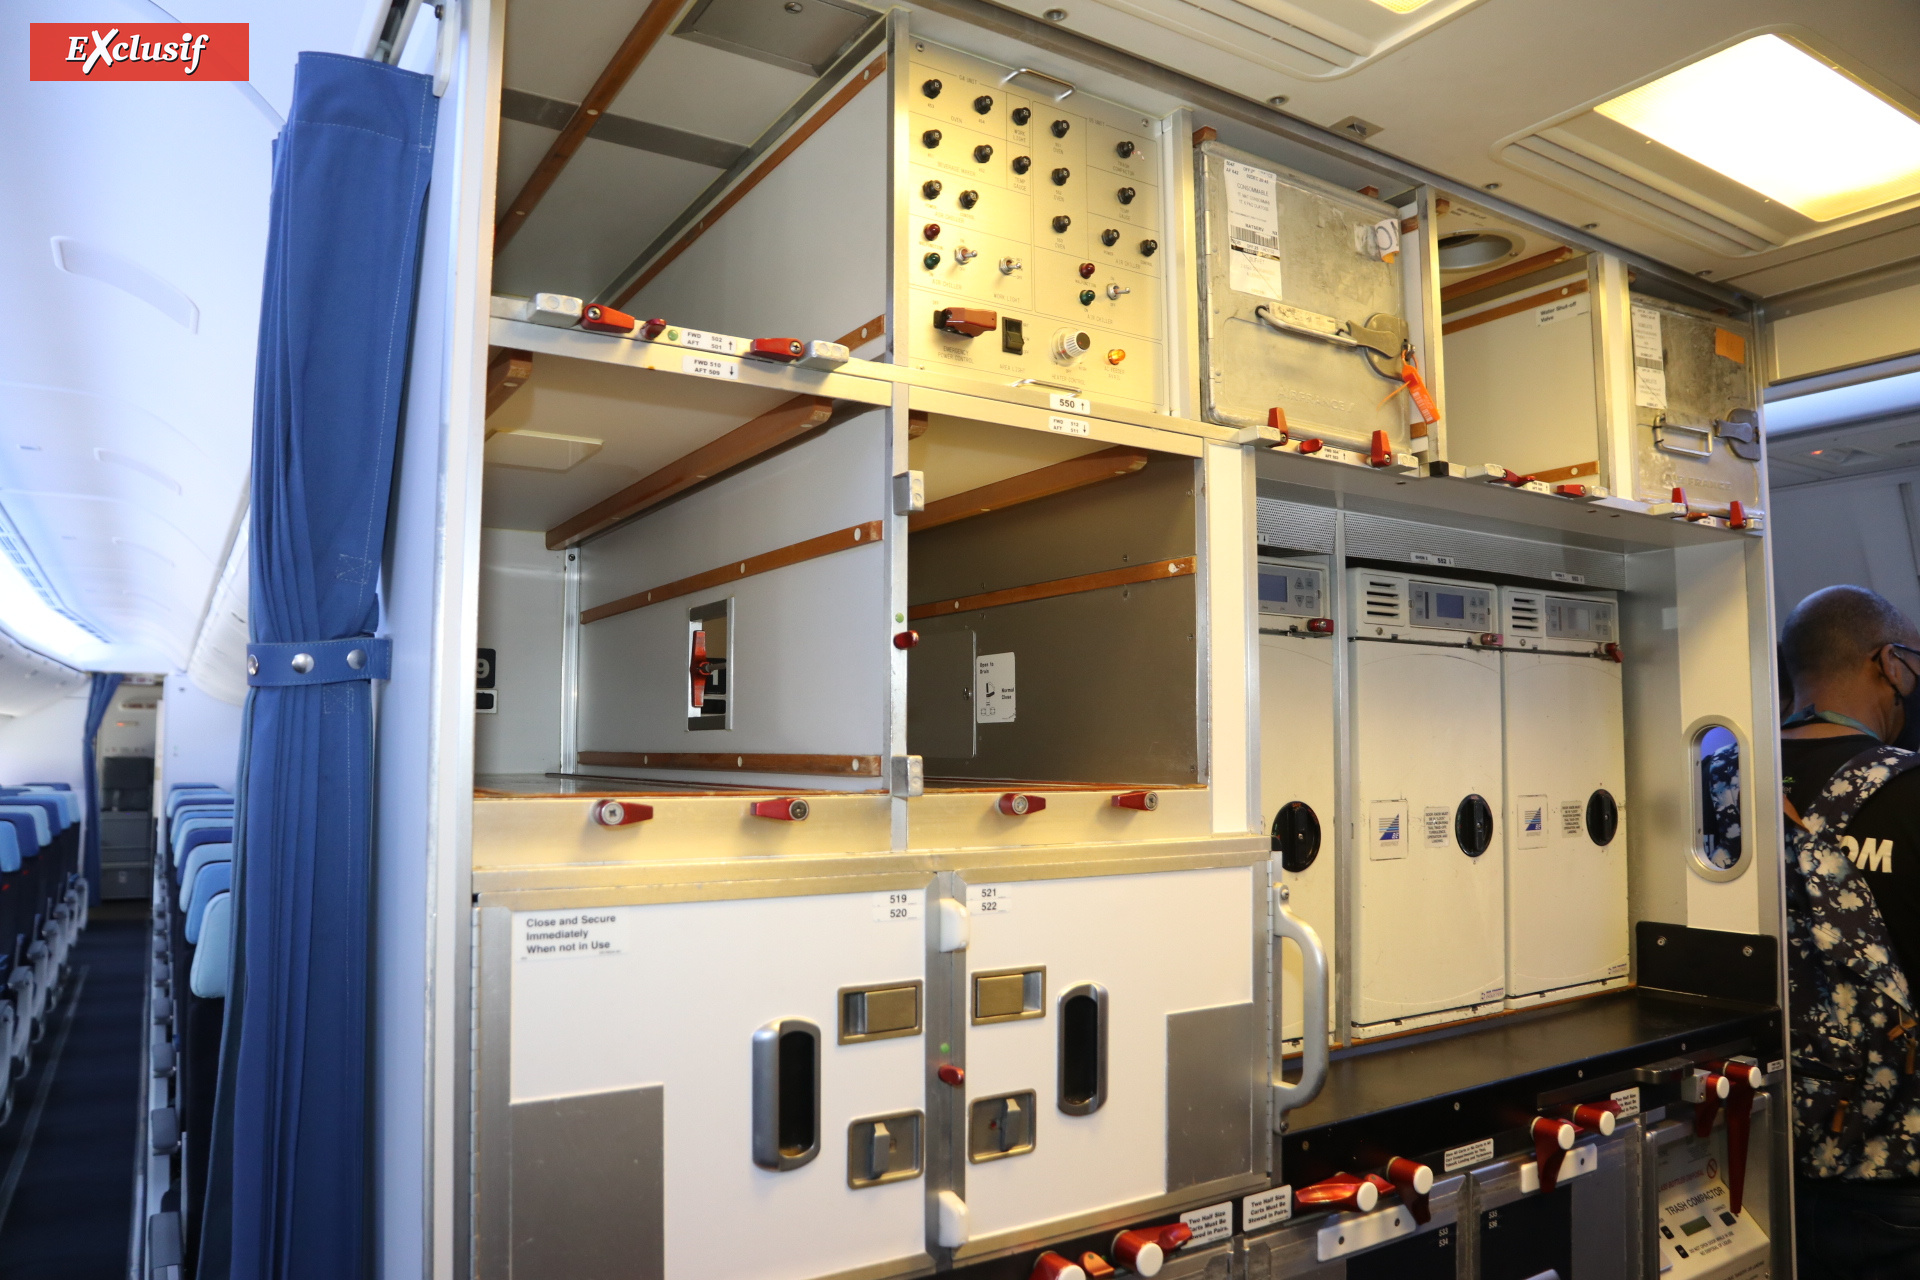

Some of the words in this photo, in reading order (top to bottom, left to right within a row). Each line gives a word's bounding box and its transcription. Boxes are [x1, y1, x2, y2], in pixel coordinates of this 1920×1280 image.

[711, 335, 723, 343] 502
[943, 345, 969, 355] EMERGENCY
[1059, 398, 1075, 409] 550
[1437, 557, 1447, 565] 552
[981, 888, 997, 898] 521
[889, 894, 907, 904] 519
[981, 902, 997, 911] 522
[889, 908, 907, 918] 520
[526, 918, 556, 928] Close
[559, 916, 578, 926] and
[581, 914, 616, 924] Secure
[526, 929, 589, 941] Immediately
[526, 944, 556, 954] When
[559, 943, 575, 952] not
[578, 942, 588, 950] in
[591, 940, 611, 949] Use
[1665, 1202, 1689, 1216] TRASH
[1686, 1186, 1726, 1208] COMPACTOR
[1250, 1208, 1265, 1216] Carts
[1265, 1204, 1278, 1212] Must
[1189, 1217, 1201, 1225] Two
[1215, 1210, 1226, 1218] Size
[1248, 1215, 1267, 1224] Stowed
[1274, 1209, 1289, 1217] Pairs.
[1204, 1221, 1218, 1229] Must
[1213, 1226, 1229, 1234] Pairs.
